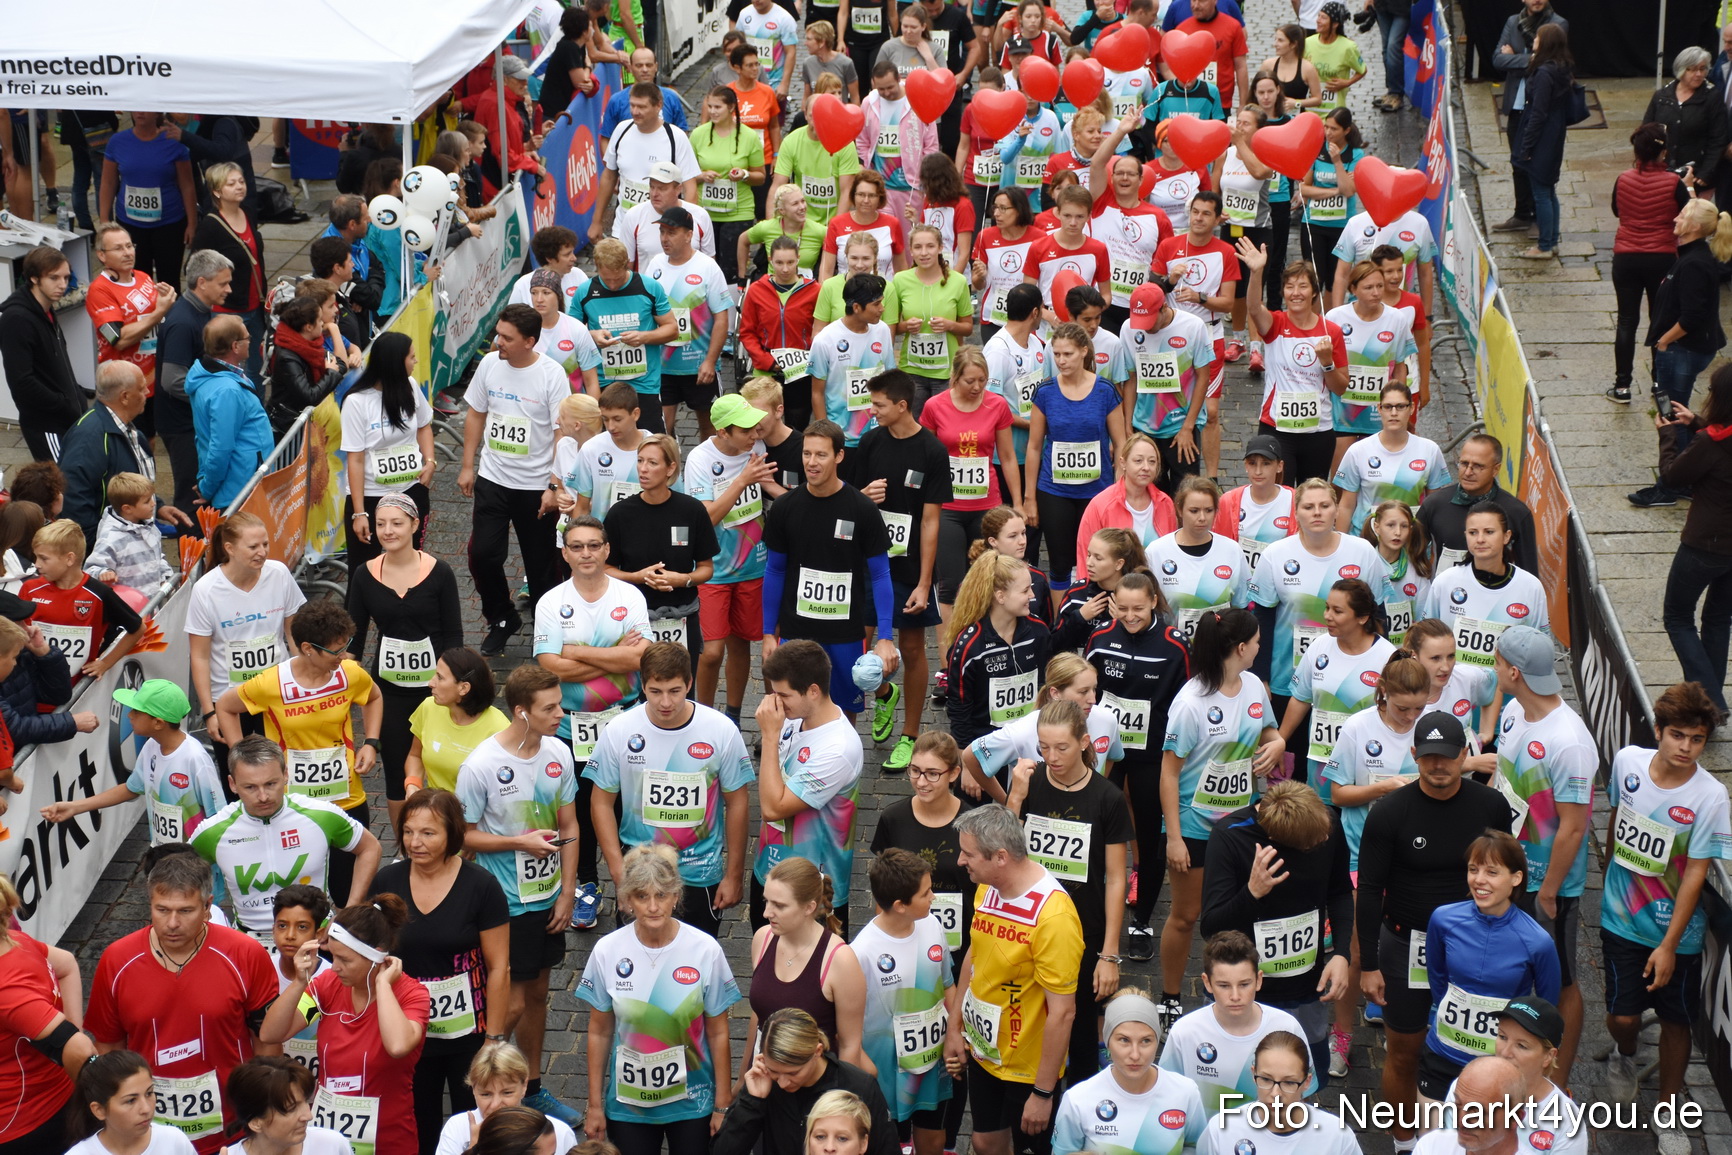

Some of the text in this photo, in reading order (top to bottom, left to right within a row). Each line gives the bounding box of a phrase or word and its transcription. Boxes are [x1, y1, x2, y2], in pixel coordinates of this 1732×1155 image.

[855, 13, 879, 24] 5114
[7, 80, 108, 96] frei zu sein.
[568, 141, 596, 198] Hervis
[624, 187, 650, 203] 5273
[706, 186, 733, 200] 5098
[805, 184, 834, 197] 5099
[128, 194, 158, 209] 2898
[1226, 194, 1255, 210] 5308
[1314, 195, 1343, 208] 5080
[1113, 267, 1144, 285] 5198
[599, 313, 639, 324] HUBER
[911, 341, 944, 354] 5137
[1168, 337, 1186, 346] Hervis
[606, 349, 642, 365] 5100
[779, 351, 808, 367] 5086
[1141, 363, 1174, 378] 5225
[1146, 380, 1172, 388] Chodadad
[1348, 375, 1383, 390] 5151
[489, 390, 521, 402] RÖDL
[1352, 393, 1376, 401] Susanne
[1281, 402, 1317, 416] 5053
[491, 422, 526, 442] 5143
[960, 432, 978, 441] WE
[496, 442, 516, 453] Tassilo
[378, 455, 417, 474] 5058
[1058, 452, 1096, 468] 5050
[384, 474, 414, 484] Anastasia
[950, 469, 984, 483] 5113
[1062, 471, 1092, 479] Katharina
[953, 487, 977, 495] Theresa
[738, 508, 752, 516] Leon
[1215, 566, 1231, 576] Hervis
[1340, 565, 1359, 576] Hervis
[804, 581, 846, 602] 5010
[808, 605, 836, 613] Andreas
[1507, 606, 1530, 615] Hervis
[221, 613, 266, 628] RÖDL
[232, 646, 275, 669] 5007
[386, 650, 430, 669] 5160
[985, 655, 1007, 664] GLAS
[1462, 654, 1494, 665] Nadezda
[986, 662, 1007, 673] Götz
[1104, 660, 1126, 669] GLAS
[1105, 667, 1124, 678] Götz
[996, 683, 1034, 706] 5049
[285, 694, 348, 717] MAX BÖGL
[1454, 701, 1470, 714] Hervis
[1006, 708, 1024, 719] Sarah
[1209, 726, 1226, 734] PARTL
[692, 746, 711, 756] Hervis
[295, 760, 343, 782] 5252
[546, 763, 562, 777] Hervis
[170, 774, 189, 788] Hervis
[1204, 772, 1248, 794] 5096
[308, 787, 330, 796] Lydia
[500, 784, 518, 793] PARTL
[650, 784, 700, 807] 5231
[1208, 798, 1240, 806] Johanna
[1622, 792, 1633, 804] PARTL
[660, 811, 688, 821] Florian
[1672, 807, 1694, 822] Hervis
[1029, 830, 1084, 860] 5272
[1616, 818, 1666, 859] 5200
[1616, 847, 1650, 868] Abdullah
[242, 899, 259, 908] KW
[1656, 901, 1670, 912] 17.
[972, 920, 994, 933] MAX
[1265, 927, 1313, 958] 5162
[1274, 958, 1305, 971] Thomas
[676, 971, 697, 980] Hervis
[965, 1007, 993, 1043] 5163
[903, 1016, 947, 1052] 5164
[1455, 1032, 1486, 1049] Sophia
[169, 1047, 188, 1059] DEHN
[923, 1052, 937, 1063] Luis
[622, 1062, 680, 1088] 5192
[334, 1081, 350, 1089] DEHN
[640, 1091, 662, 1099] Gabi
[155, 1091, 214, 1117] 5128
[315, 1106, 370, 1140] 5127
[1163, 1114, 1185, 1124] Hervis
